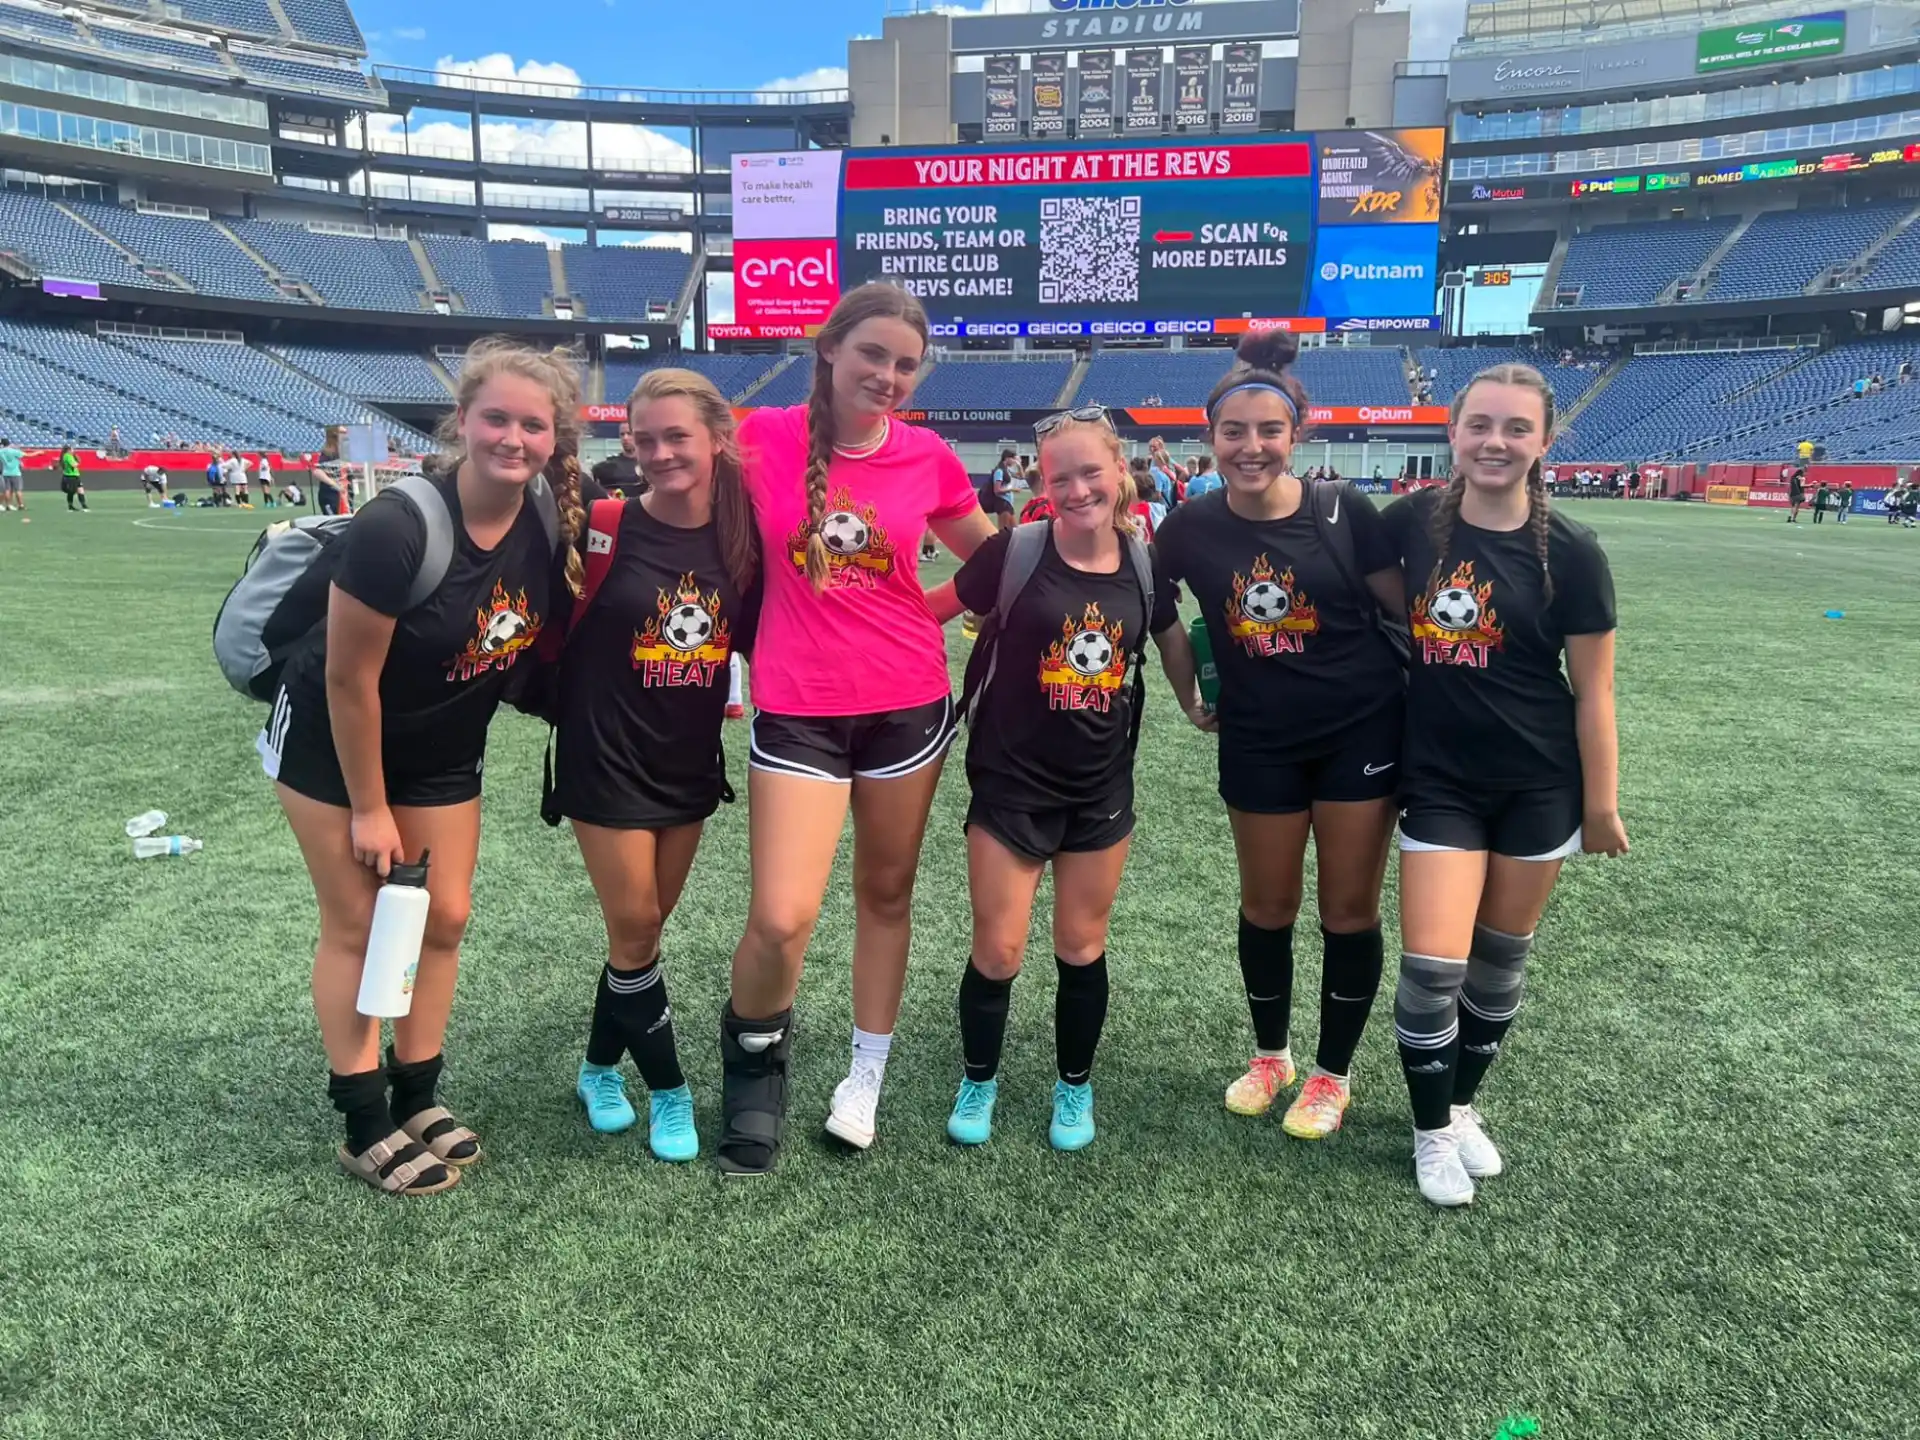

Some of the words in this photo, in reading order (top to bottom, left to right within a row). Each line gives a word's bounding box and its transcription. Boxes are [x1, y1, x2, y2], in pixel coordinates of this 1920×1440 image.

[1041, 11, 1203, 38] STADIUM
[1494, 59, 1580, 82] Encore
[1033, 121, 1062, 130] 2003
[1080, 118, 1110, 128] 2004
[1128, 117, 1156, 126] 2014
[1176, 116, 1205, 124] 2016
[1225, 113, 1254, 123] 2018
[988, 123, 1015, 132] 2001
[915, 159, 983, 184] YOUR
[988, 156, 1067, 182] NIGHT
[1071, 154, 1103, 179] AT
[1108, 153, 1158, 177] THE
[1165, 150, 1231, 176] REVS
[742, 181, 753, 190] To
[755, 181, 780, 190] make
[783, 180, 813, 190] health
[1697, 172, 1744, 185] BIOMED
[742, 196, 762, 204] care
[764, 194, 795, 204] better,
[1492, 187, 1524, 197] Mutual
[1349, 191, 1401, 217] XDR
[620, 209, 641, 220] 2021
[883, 207, 941, 226] BRING
[944, 205, 997, 224] YOUR
[855, 231, 939, 251] FRIENDS,
[942, 230, 994, 249] TEAM
[998, 229, 1026, 248] OR
[1200, 222, 1258, 244] SCAN
[1263, 222, 1288, 242] FOR
[881, 255, 947, 273] ENTIRE
[951, 254, 999, 272] CLUB
[1152, 250, 1206, 268] MORE
[1210, 248, 1287, 267] DETAILS
[741, 248, 834, 288] enel
[1340, 263, 1423, 280] Putnam
[1484, 272, 1509, 284] 3:05
[903, 278, 950, 297] REVS
[953, 277, 1013, 296] GAME!
[709, 327, 752, 337] TOYOTA
[760, 326, 803, 336] TOYOTA
[928, 324, 958, 335] ICO
[966, 324, 1020, 335] GEICO
[1028, 322, 1081, 334] GEICO
[1091, 322, 1146, 333] GEICO
[1155, 321, 1211, 333] GEICO
[1368, 319, 1430, 329] EMPOWER
[928, 411, 960, 420] FIELD
[963, 411, 1012, 421] LOUNGE
[1358, 406, 1413, 423] Optum
[828, 564, 877, 590] EAT
[1243, 631, 1305, 658] HEAT
[1423, 637, 1494, 668] HEAT
[643, 658, 721, 688] HEAT
[1049, 682, 1115, 713] HEAT
